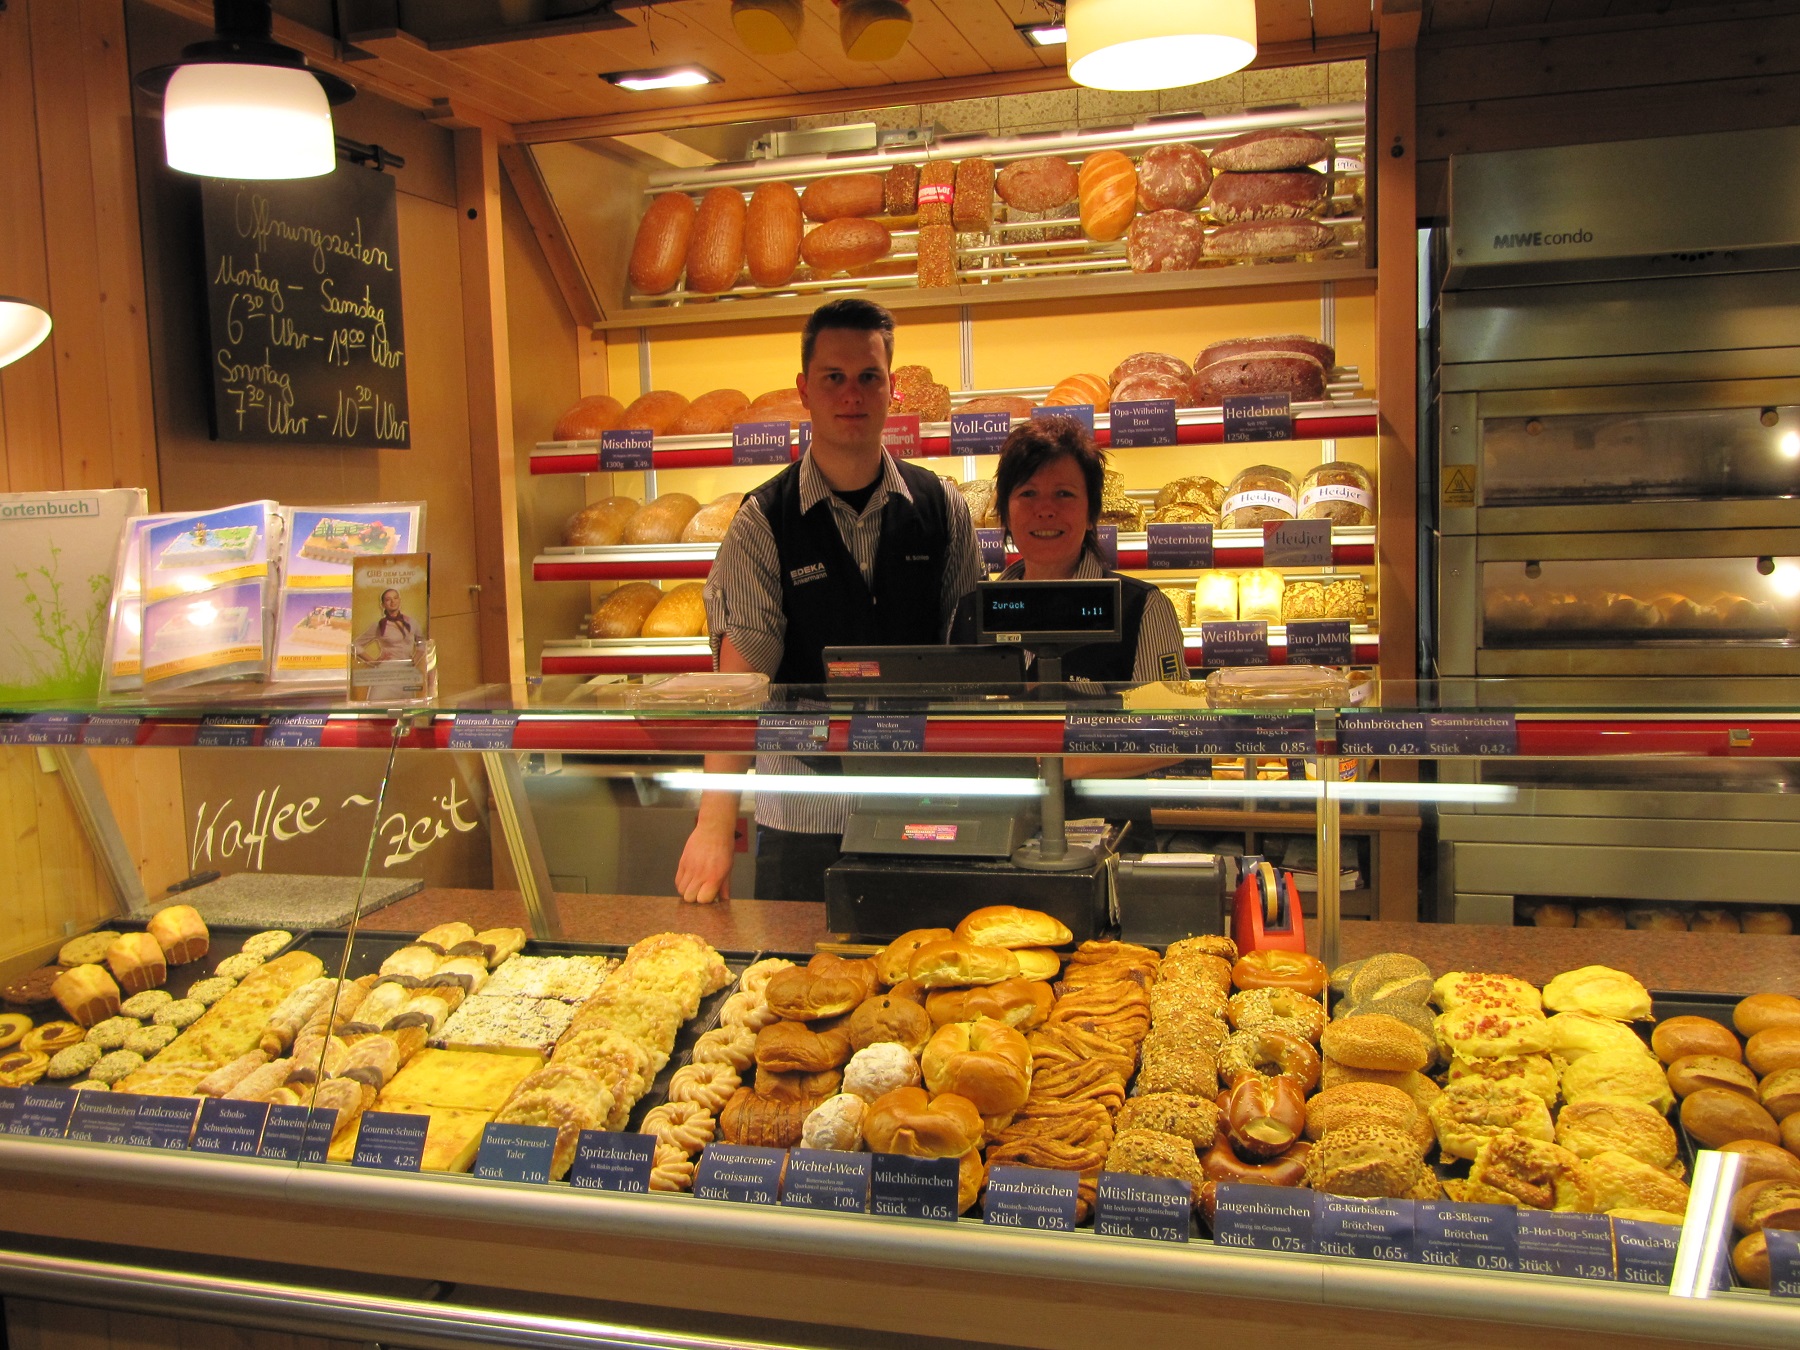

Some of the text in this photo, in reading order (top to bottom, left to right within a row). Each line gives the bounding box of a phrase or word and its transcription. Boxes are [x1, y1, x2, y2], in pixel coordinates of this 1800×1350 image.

[235, 184, 394, 274] Öffnungszeiten
[1493, 228, 1593, 249] MIWE condo
[214, 253, 388, 344] Montag Samstag
[270, 314, 310, 350] Uhr
[371, 334, 404, 369] Uhr
[217, 346, 295, 408] Sonntag
[267, 394, 309, 434] Uhr
[375, 393, 409, 442] Uhr
[1114, 406, 1168, 417] Opa-Wilhelm-
[1226, 405, 1289, 419] Heidebrot
[953, 421, 1008, 434] Voll-Gut
[1133, 418, 1150, 426] Brot
[602, 438, 652, 450] Mischbrot
[734, 432, 785, 448] Laibling
[1115, 438, 1133, 446] 750g
[1226, 433, 1250, 442] 1250g
[956, 446, 974, 455] 750g
[1240, 493, 1282, 504] Heidjer
[1319, 487, 1362, 500] Heidjer
[0, 499, 90, 518] ortenbuch
[1147, 534, 1210, 545] Westernbrot
[1275, 531, 1324, 546] Heidjer
[789, 562, 826, 579] EDEKA
[1152, 560, 1170, 568] 500g
[1202, 629, 1265, 643] Weißbrot
[1288, 632, 1350, 646] Euro JMMK
[1207, 658, 1226, 666] 500g
[1292, 656, 1311, 665] 550g
[89, 716, 141, 726] Zitronenzwerg
[203, 716, 255, 726] Apfeltaschen
[269, 716, 323, 726] Zauberkissen
[455, 718, 515, 726] Irmtrauds Bester
[760, 718, 825, 727] Butter-Croissant
[1069, 715, 1142, 726] Laugenecke
[1338, 719, 1423, 730] Mohnbrötchen
[1430, 717, 1509, 727] Sesambrötchen
[27, 733, 48, 742] Stück
[1172, 727, 1203, 737] Bagels
[1256, 726, 1289, 737] Bagels
[83, 736, 102, 744] Stück
[198, 736, 219, 745] Stück
[264, 738, 286, 747] Stück
[451, 740, 473, 748] Stück
[757, 741, 781, 750] Stück
[852, 740, 880, 750] Stück
[1068, 741, 1099, 752] Stück
[1149, 743, 1179, 754] Stück
[1235, 742, 1266, 753] Stück
[1342, 743, 1373, 754] Stück
[1430, 743, 1460, 753] Stück
[192, 778, 478, 870] Kaffee Zeit
[23, 1095, 66, 1110] Korntaler
[78, 1102, 136, 1116] Streuselkuchen
[138, 1105, 192, 1119] Landcrossie
[219, 1108, 247, 1119] Schoko-
[9, 1123, 30, 1135] Stück
[202, 1122, 255, 1137] Schweineohren
[362, 1125, 425, 1138] Gourmet-Schnitte
[71, 1131, 92, 1142] Stück
[128, 1135, 152, 1146] Stück
[196, 1136, 220, 1149] Stück
[486, 1135, 550, 1149] Butter-Streusel-
[261, 1146, 287, 1159] Stück
[357, 1151, 382, 1164] Stück
[506, 1150, 526, 1159] Taler
[580, 1146, 649, 1162] Spritzkuchen
[709, 1151, 776, 1166] Nougatcreme-
[479, 1166, 503, 1178] Stück
[790, 1160, 865, 1176] Wichtel-Weck
[575, 1175, 603, 1188] Stück
[713, 1170, 763, 1184] Croissants
[875, 1171, 954, 1188] Milchhörnchen
[700, 1186, 729, 1200] Stück
[988, 1180, 1074, 1197] Franzbrötchen
[785, 1192, 813, 1204] Stück
[1099, 1185, 1188, 1206] Müslistangen
[876, 1201, 907, 1215] Stück
[1216, 1200, 1311, 1217] Laugenhörnchen
[1328, 1203, 1399, 1216] GB-Kürbiskern-
[989, 1211, 1022, 1226] Stück
[1438, 1211, 1493, 1224] GB-SBkern-
[1100, 1221, 1134, 1236] Stück
[1342, 1220, 1385, 1232] Brötchen
[1220, 1231, 1255, 1247] Stück
[1444, 1228, 1489, 1241] Brötchen
[1320, 1241, 1356, 1256] Stück
[1421, 1249, 1459, 1266] Stück
[1518, 1258, 1553, 1273] Stück
[1624, 1267, 1664, 1284] Stück
